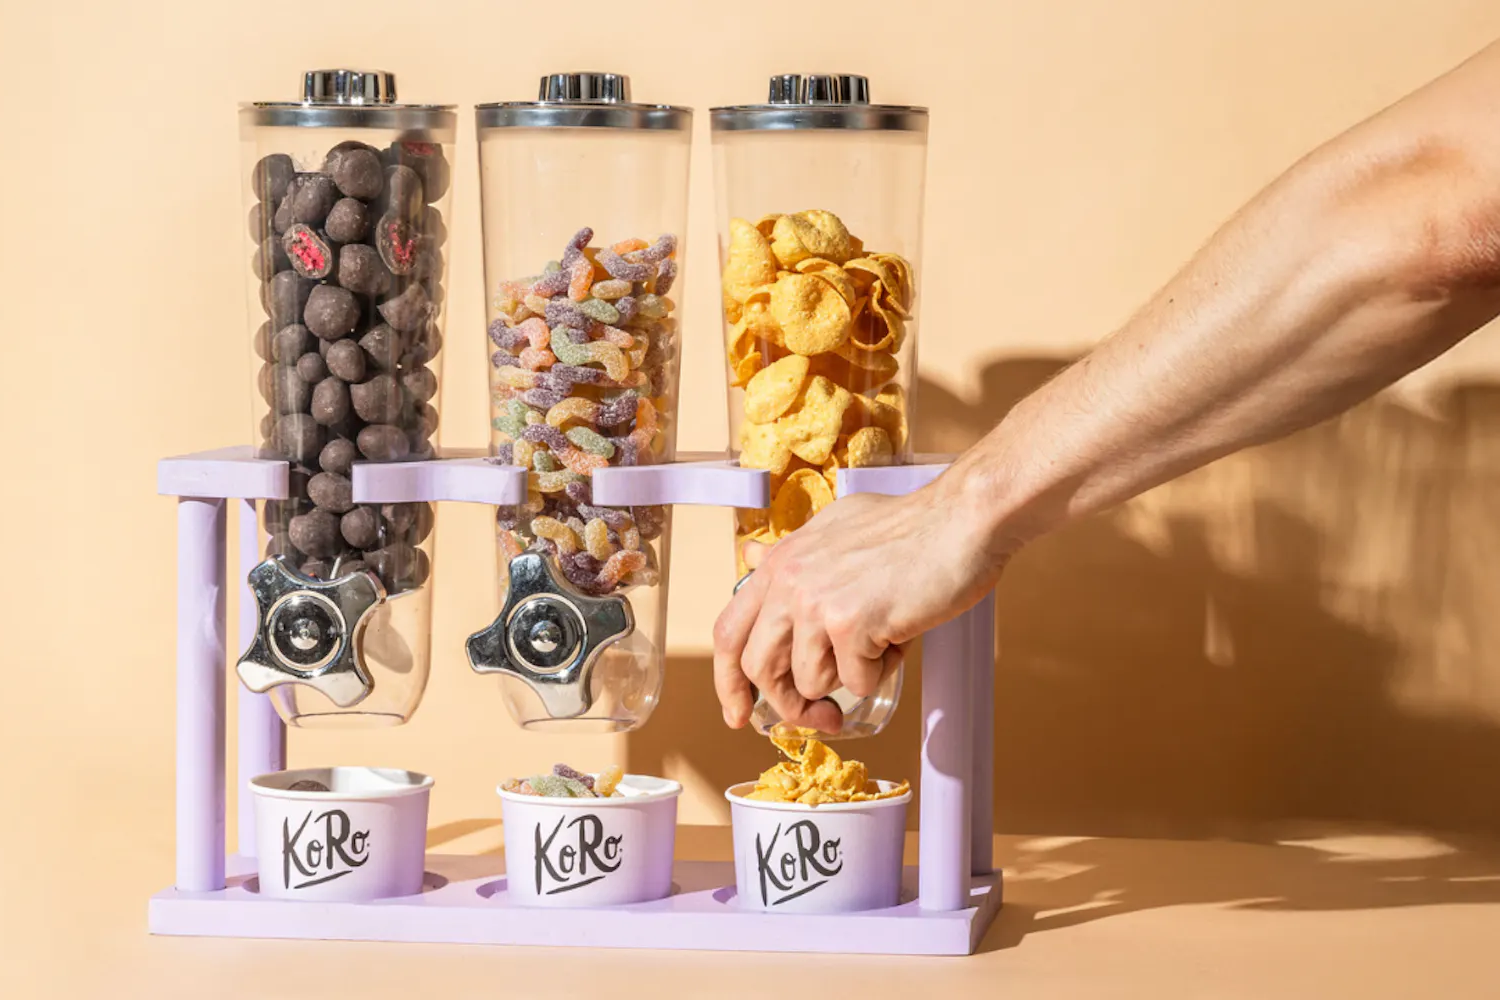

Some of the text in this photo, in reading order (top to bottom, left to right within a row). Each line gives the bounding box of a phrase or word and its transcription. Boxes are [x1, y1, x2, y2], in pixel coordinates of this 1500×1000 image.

[283, 809, 370, 889] KoRo
[534, 814, 623, 895] KoRo
[756, 819, 843, 907] KoRo
